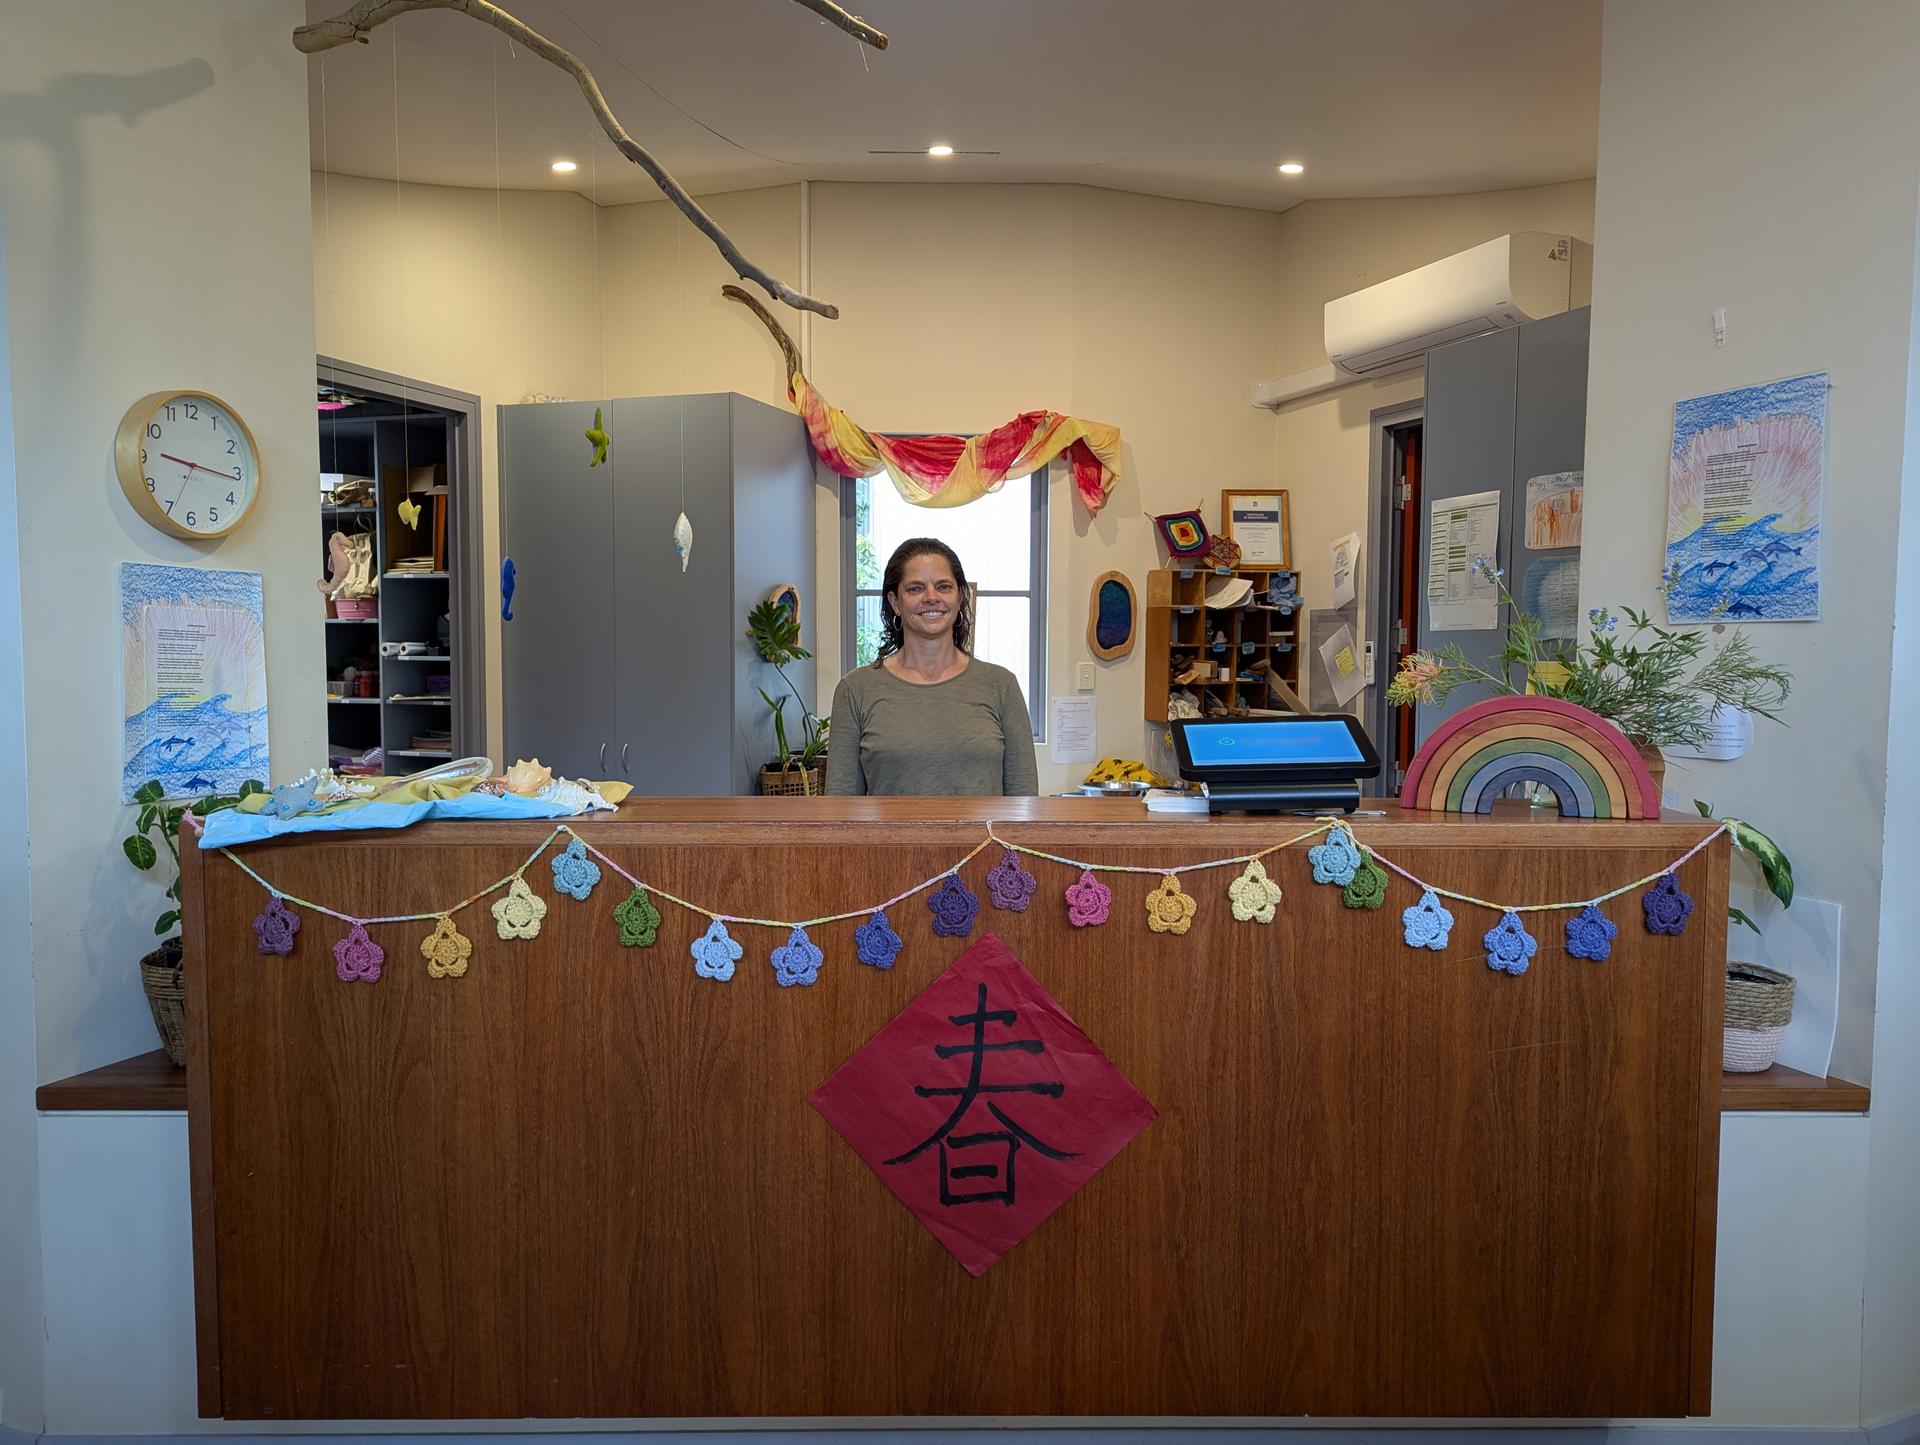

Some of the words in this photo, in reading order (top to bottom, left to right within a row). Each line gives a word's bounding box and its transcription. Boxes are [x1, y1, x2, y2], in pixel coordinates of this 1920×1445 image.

[165, 405, 176, 422] 11
[184, 403, 198, 420] 12
[146, 422, 161, 439] 10
[211, 416, 217, 431] 1
[226, 439, 235, 454] 2
[233, 466, 241, 481] 3
[145, 477, 155, 493] 8
[225, 491, 235, 505] 4
[165, 500, 174, 515] 7
[209, 507, 218, 522] 5
[186, 511, 196, 526] 6
[882, 982, 1084, 1207] 春
